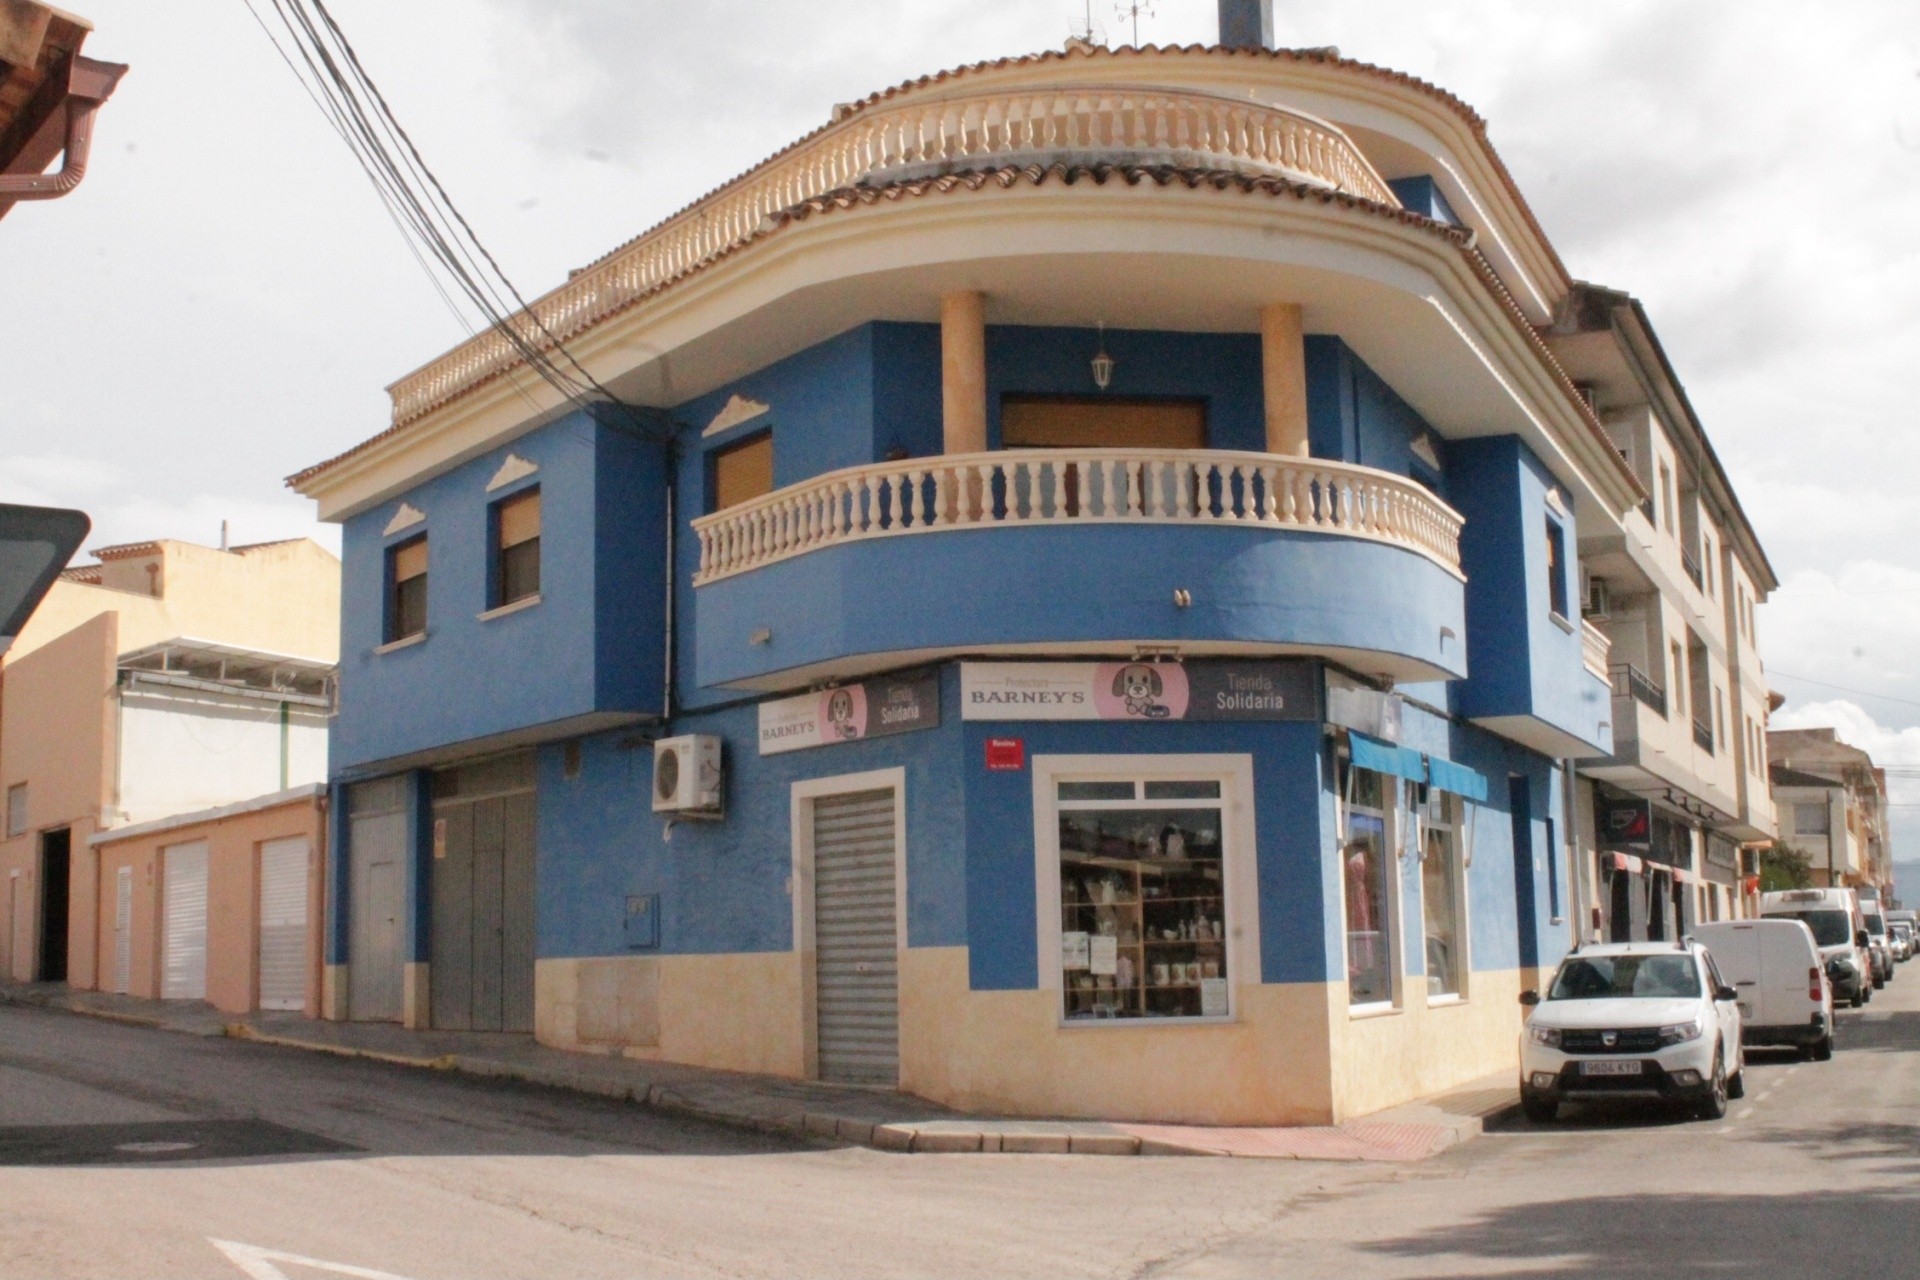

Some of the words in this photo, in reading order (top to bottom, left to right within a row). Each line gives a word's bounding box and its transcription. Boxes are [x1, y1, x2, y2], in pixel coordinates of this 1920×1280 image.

[1226, 673, 1273, 690] Tienda
[971, 691, 1085, 704] BARNEY'S
[1217, 691, 1284, 710] Solidaria
